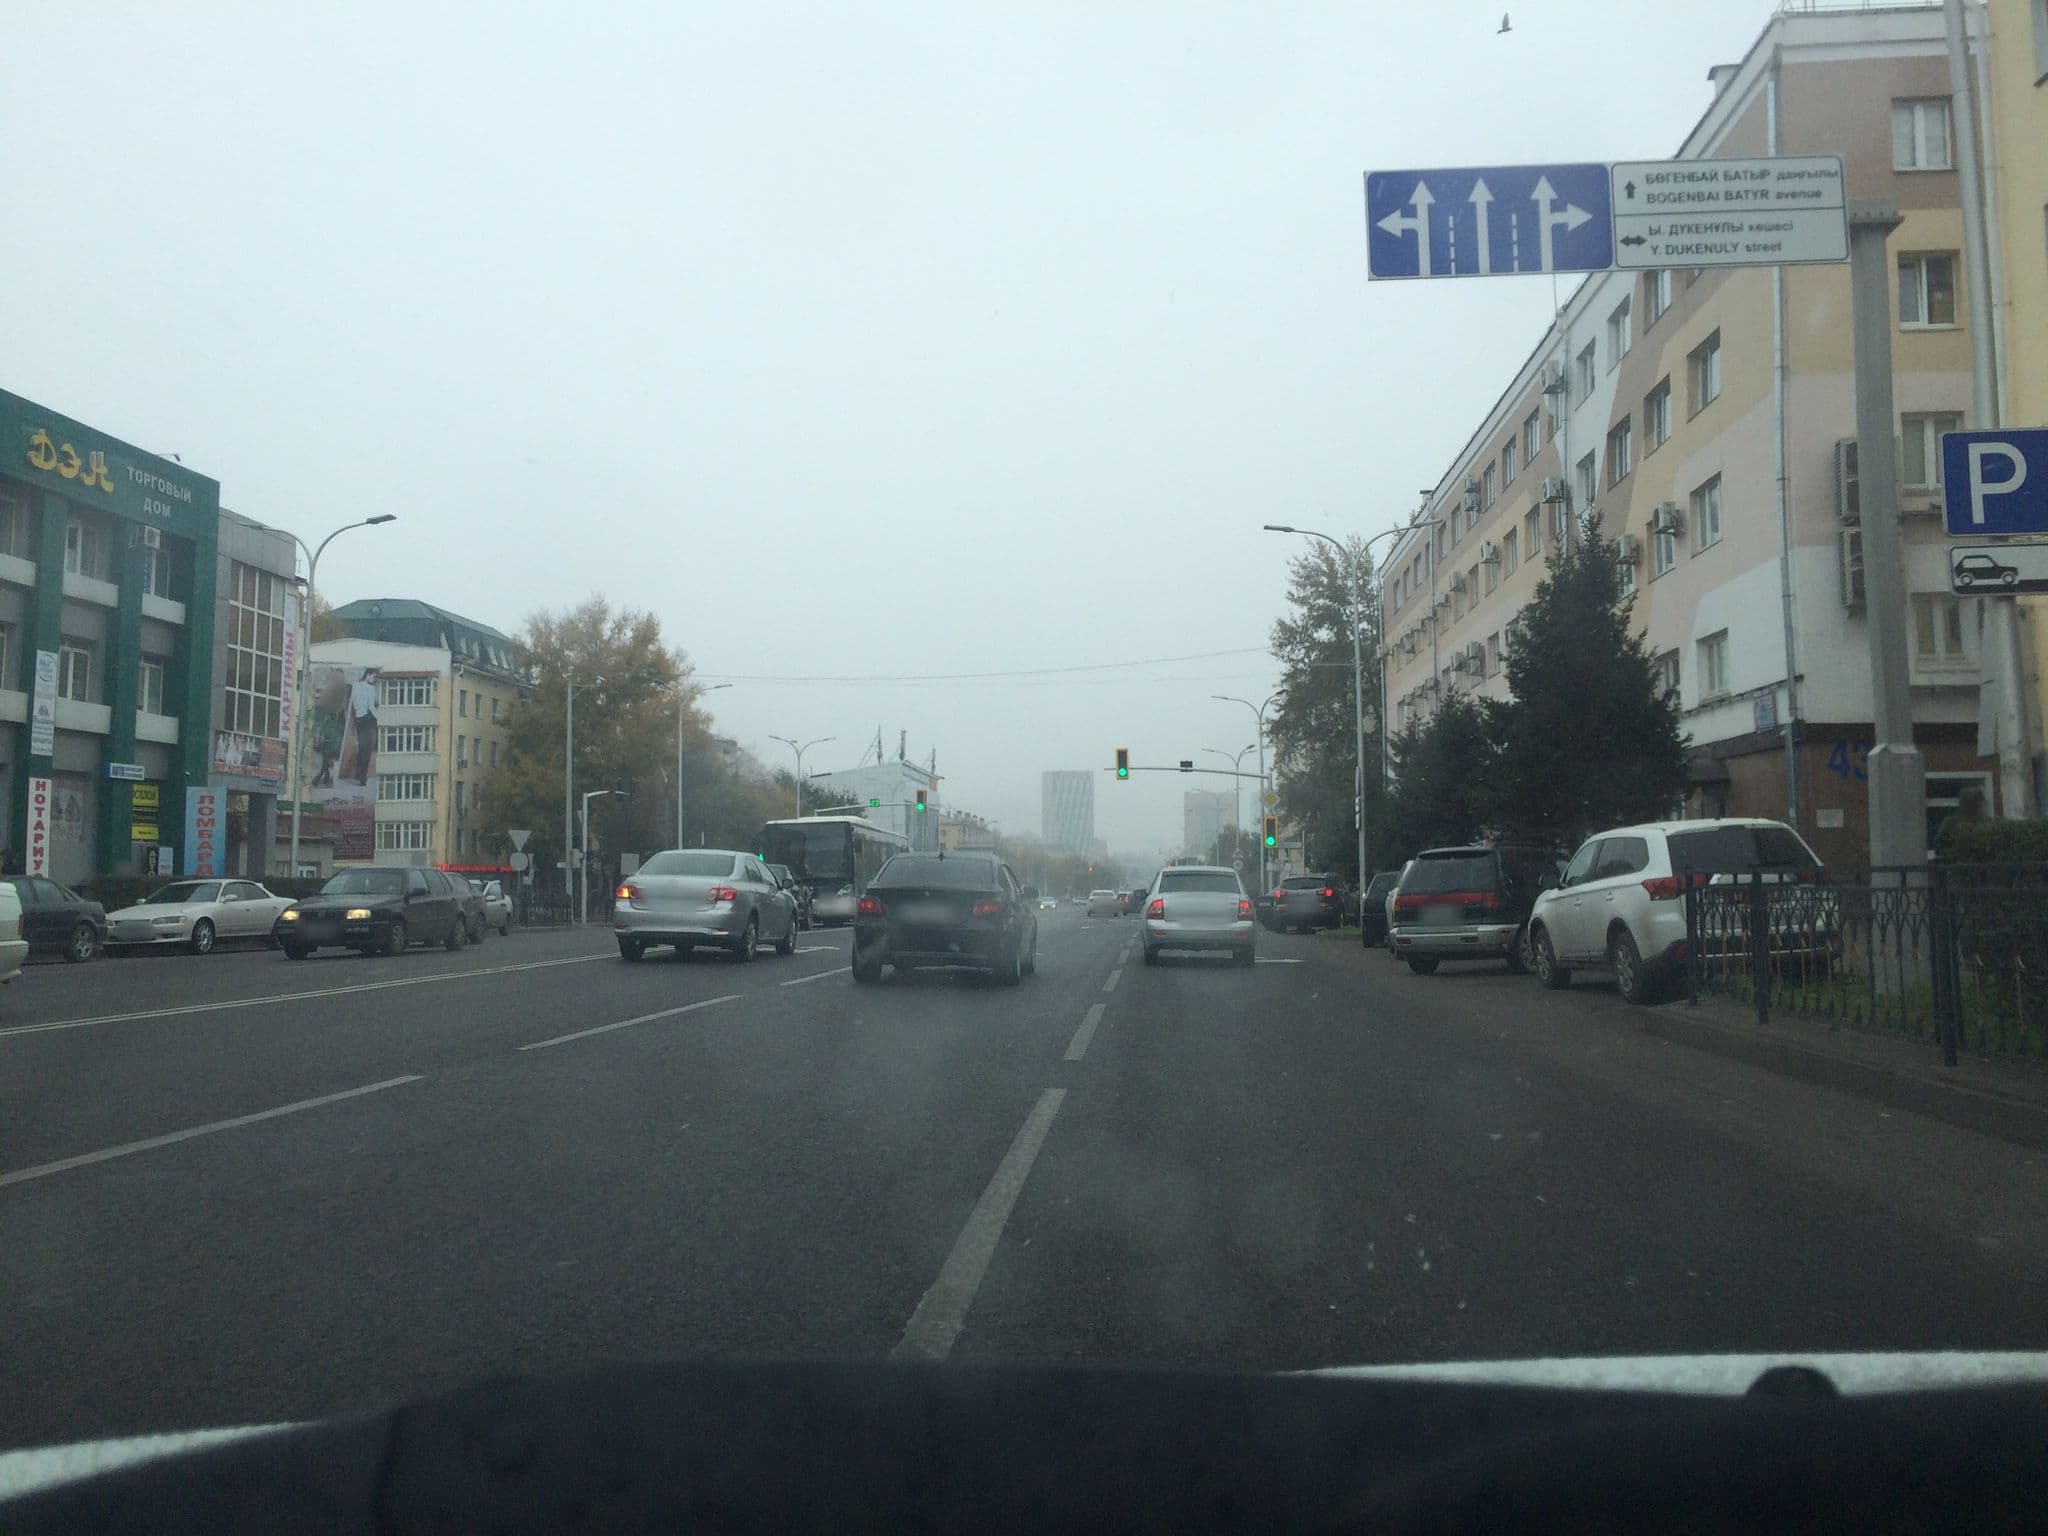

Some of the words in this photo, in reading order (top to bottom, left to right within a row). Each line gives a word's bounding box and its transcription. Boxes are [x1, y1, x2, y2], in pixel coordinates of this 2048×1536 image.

[1645, 169, 1719, 185] БӨГЕНБАЙ
[1723, 168, 1770, 182] БАТЫР
[1646, 190, 1720, 204] BOGENBAI
[1725, 189, 1769, 201] BATYR
[1775, 189, 1822, 200] avenue
[1651, 245, 1662, 256] Y.
[1666, 242, 1740, 256] DUKENULY
[1744, 241, 1782, 253] street
[127, 466, 192, 503] ТОРГОВЫЙ
[1968, 442, 2027, 524] P
[143, 498, 172, 518] ДОМ
[281, 632, 294, 732] КАРТИНЫ
[196, 795, 215, 876] ЛОМБАРД
